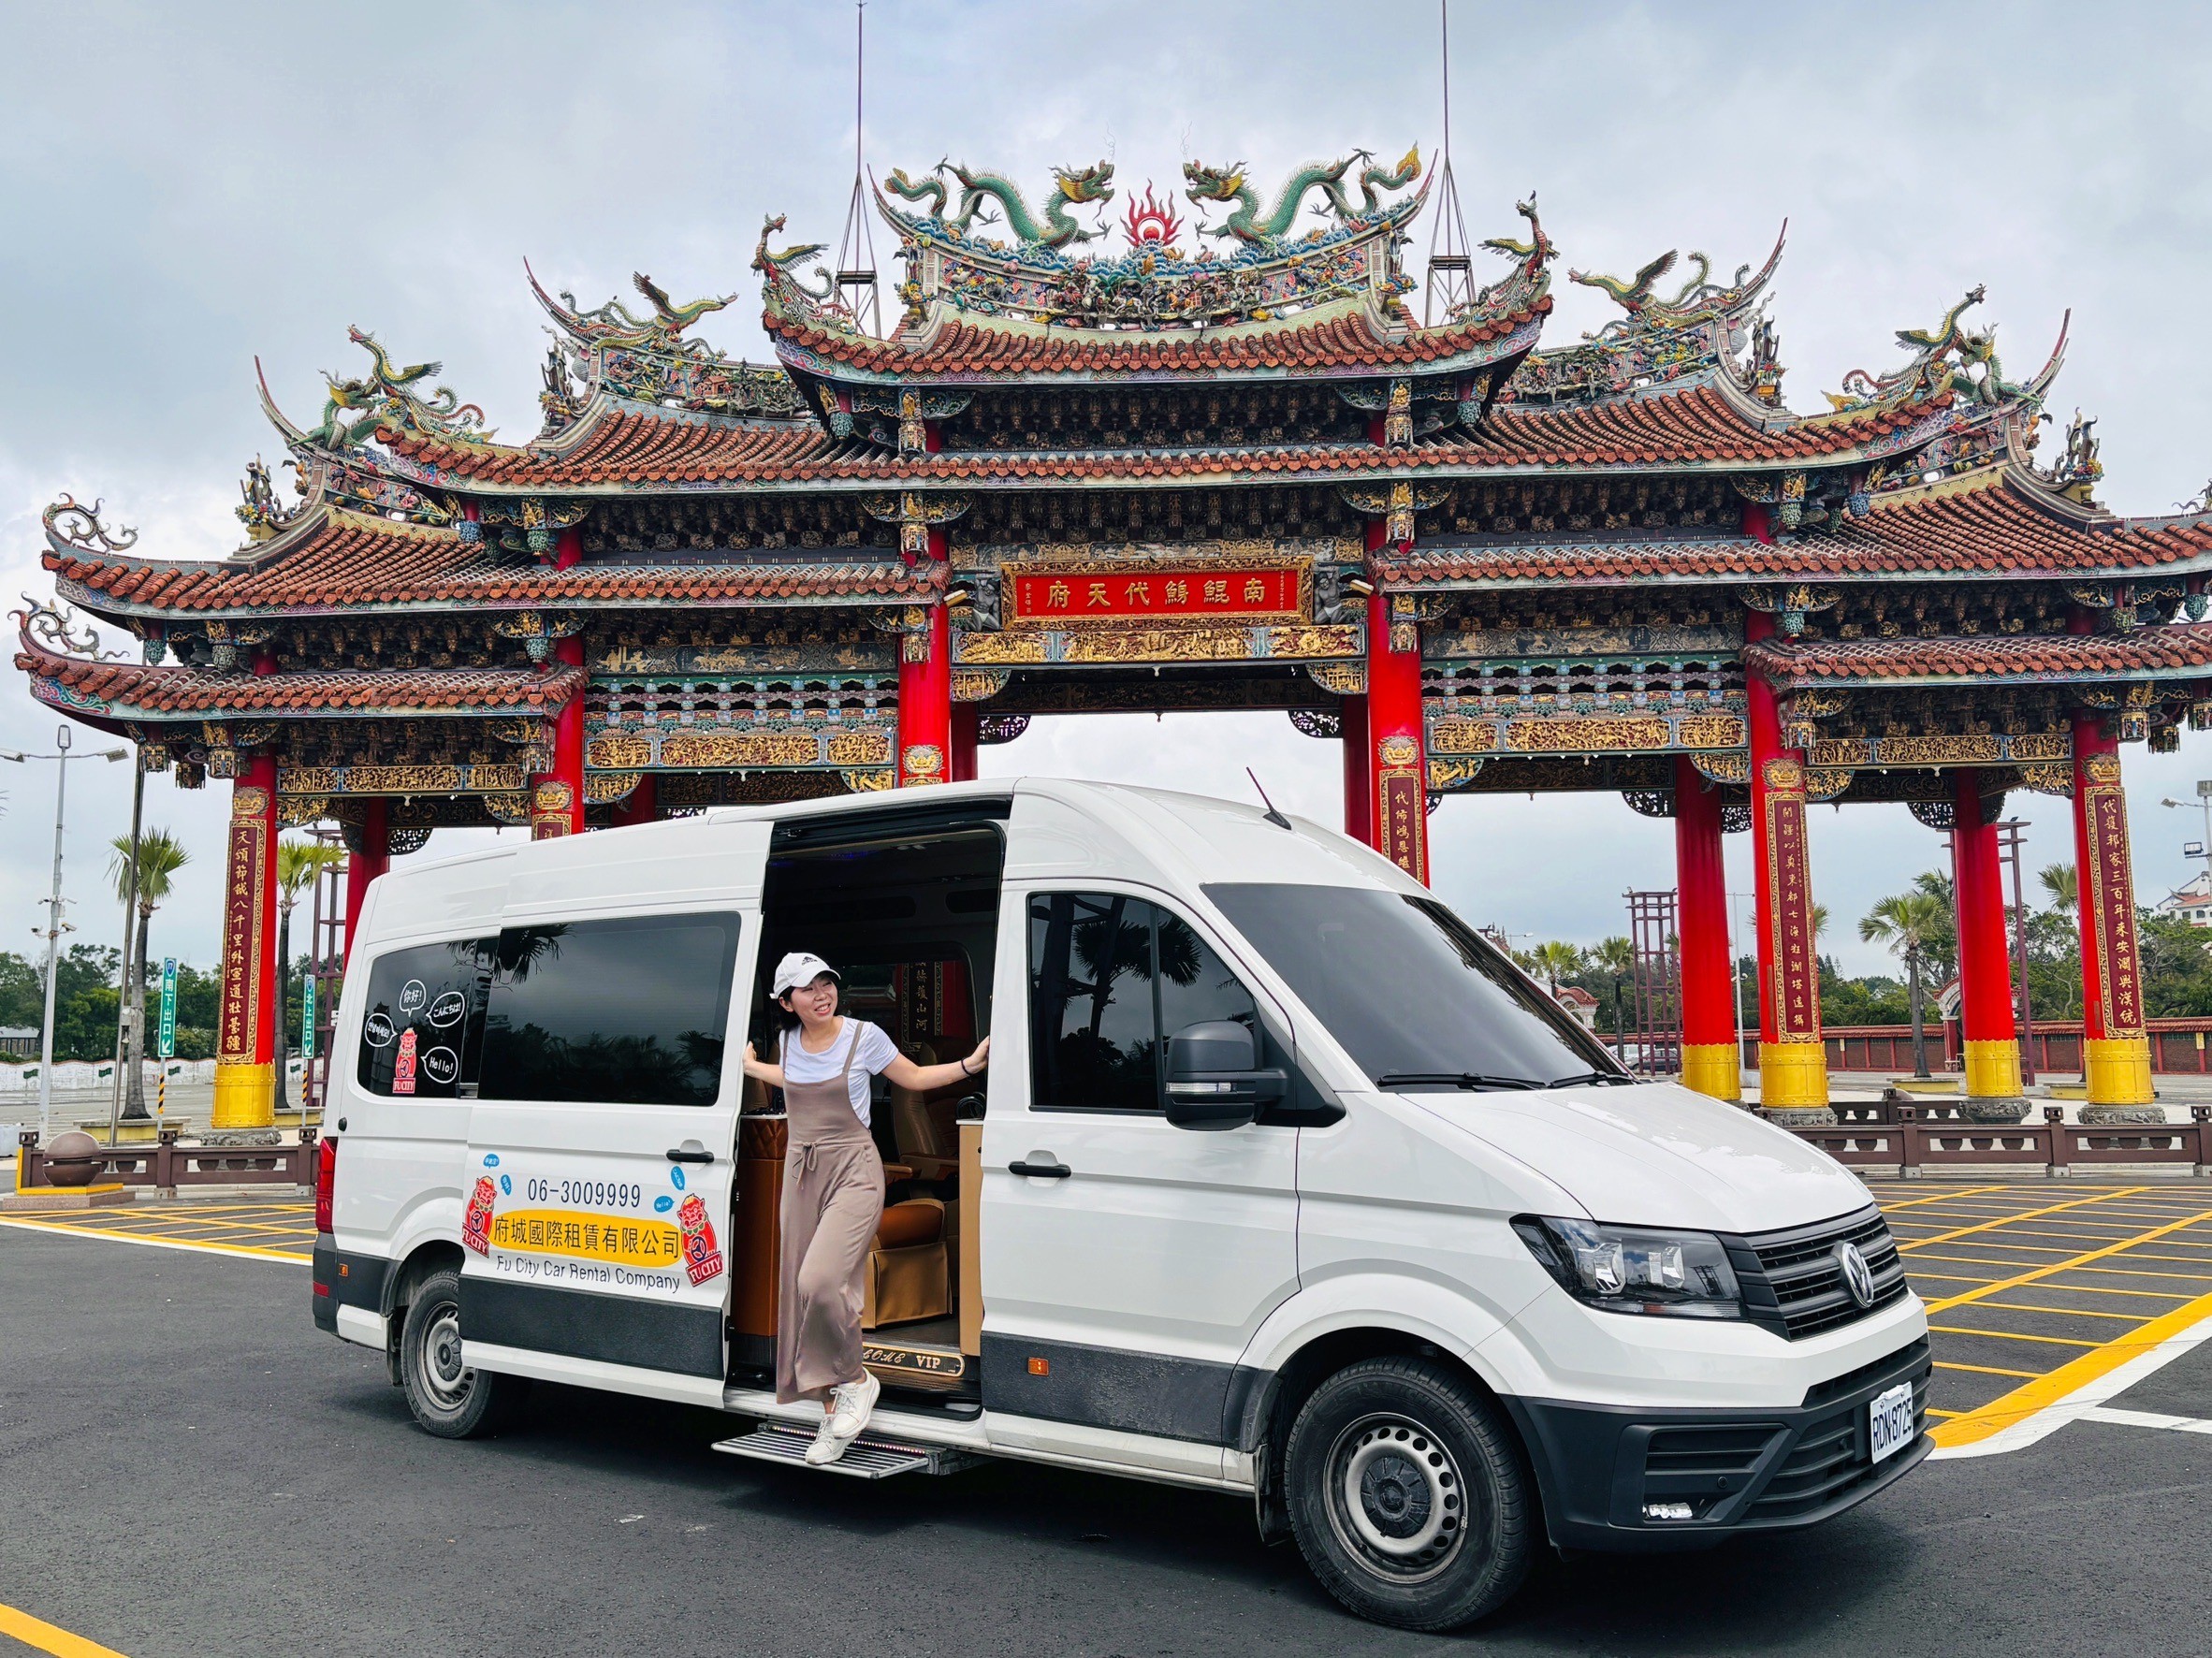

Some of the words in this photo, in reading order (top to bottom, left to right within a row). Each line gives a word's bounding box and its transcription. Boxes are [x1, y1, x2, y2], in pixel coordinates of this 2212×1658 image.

[1046, 577, 1266, 609] 南鯤鯓代天府
[163, 978, 174, 1036] 南下出口
[433, 1001, 461, 1018] こんにちは!
[429, 1055, 454, 1074] Hello!
[528, 1177, 642, 1209] 06-3009999
[493, 1215, 681, 1259] 府城國際租賃有限公司
[496, 1256, 512, 1272] Fu
[516, 1258, 539, 1278] City
[544, 1260, 565, 1278] Car
[570, 1263, 611, 1283] Rental
[615, 1268, 680, 1294] Company
[916, 1355, 941, 1369] VIP
